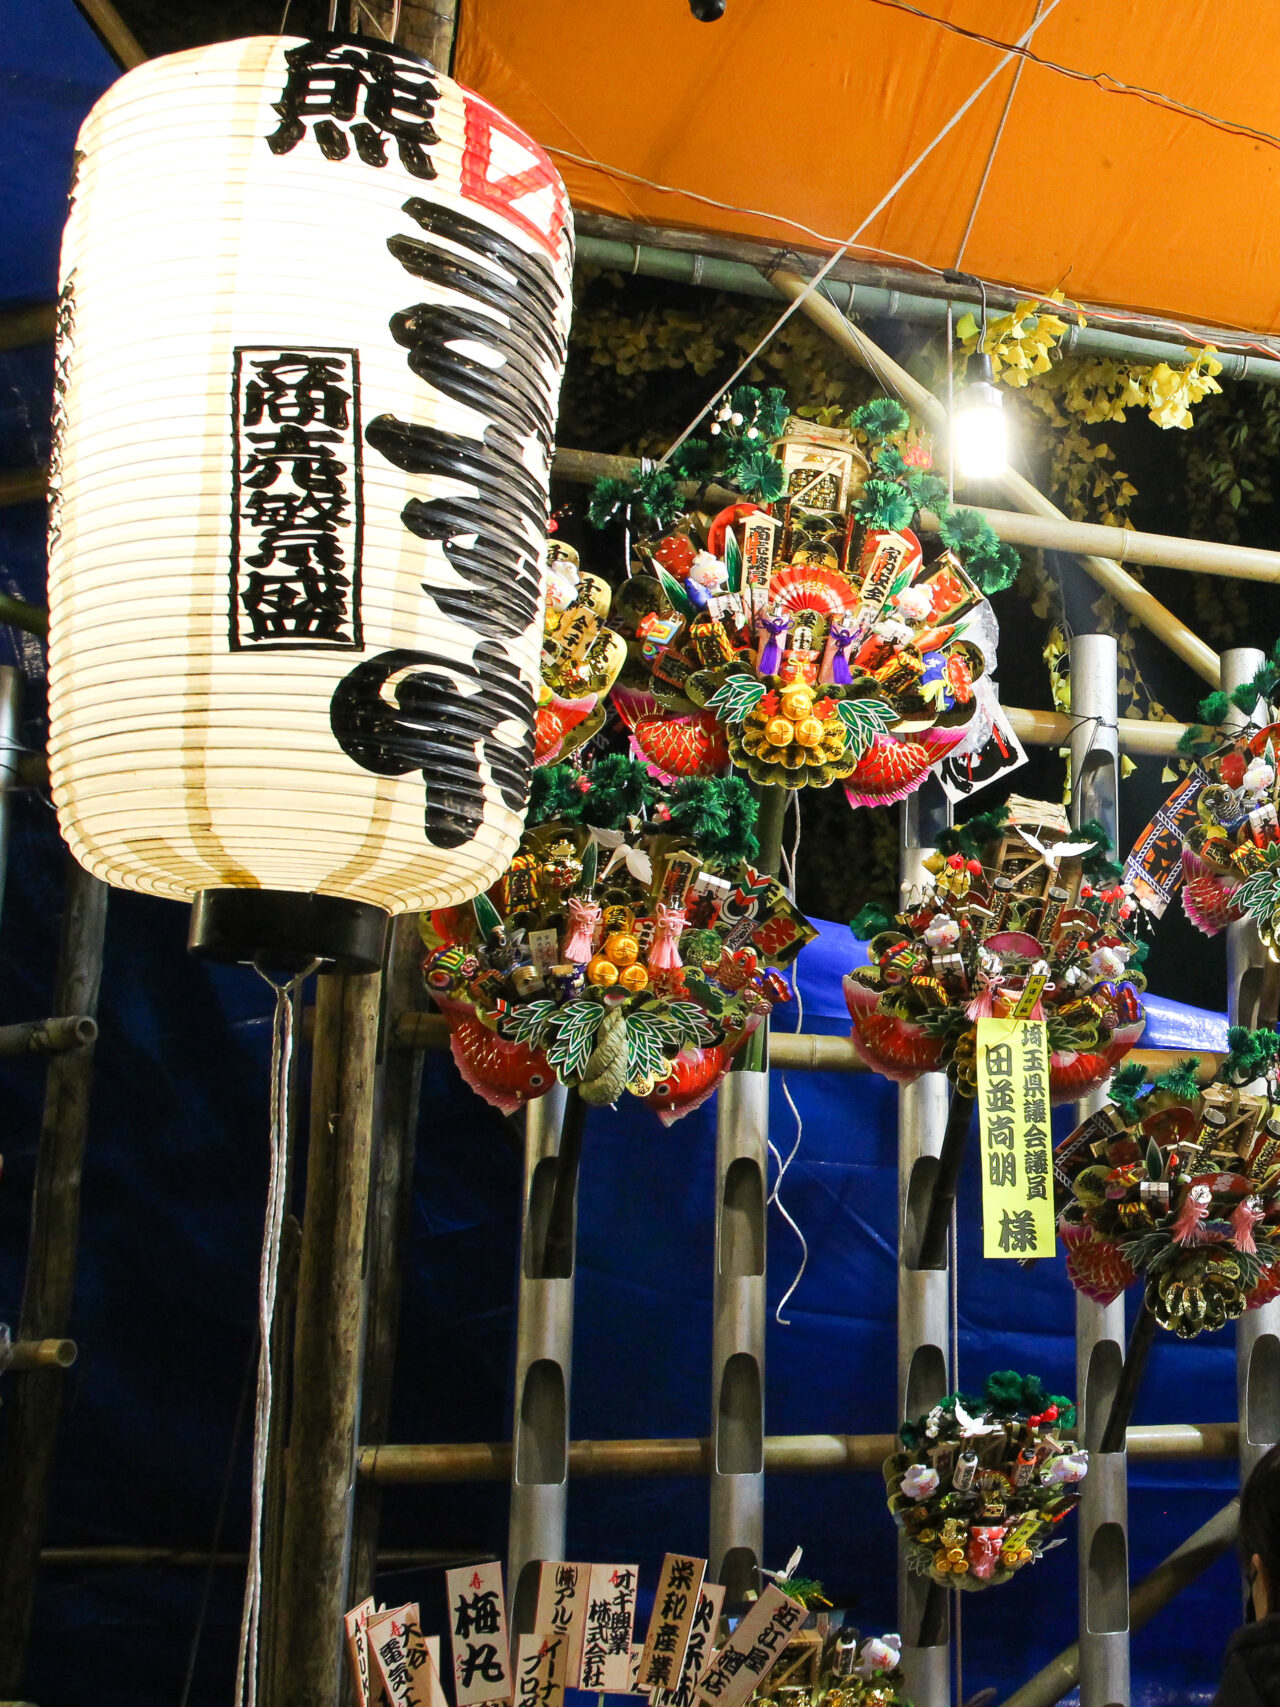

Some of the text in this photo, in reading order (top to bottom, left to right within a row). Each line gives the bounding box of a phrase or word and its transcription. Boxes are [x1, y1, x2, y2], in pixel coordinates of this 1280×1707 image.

[264, 38, 442, 180] 熊
[240, 352, 354, 642] 商売繁盛
[864, 546, 901, 603] 家内安全
[984, 1043, 1017, 1187] 田並尚明
[1021, 1022, 1049, 1201] 埼玉県議会議員
[997, 1207, 1038, 1253] 様
[400, 1622, 430, 1670] 大谷
[454, 1590, 506, 1689] 梅丸
[582, 1598, 613, 1689] 株式会社
[699, 1643, 746, 1698] 酒店
[743, 1599, 801, 1676] 近江屋
